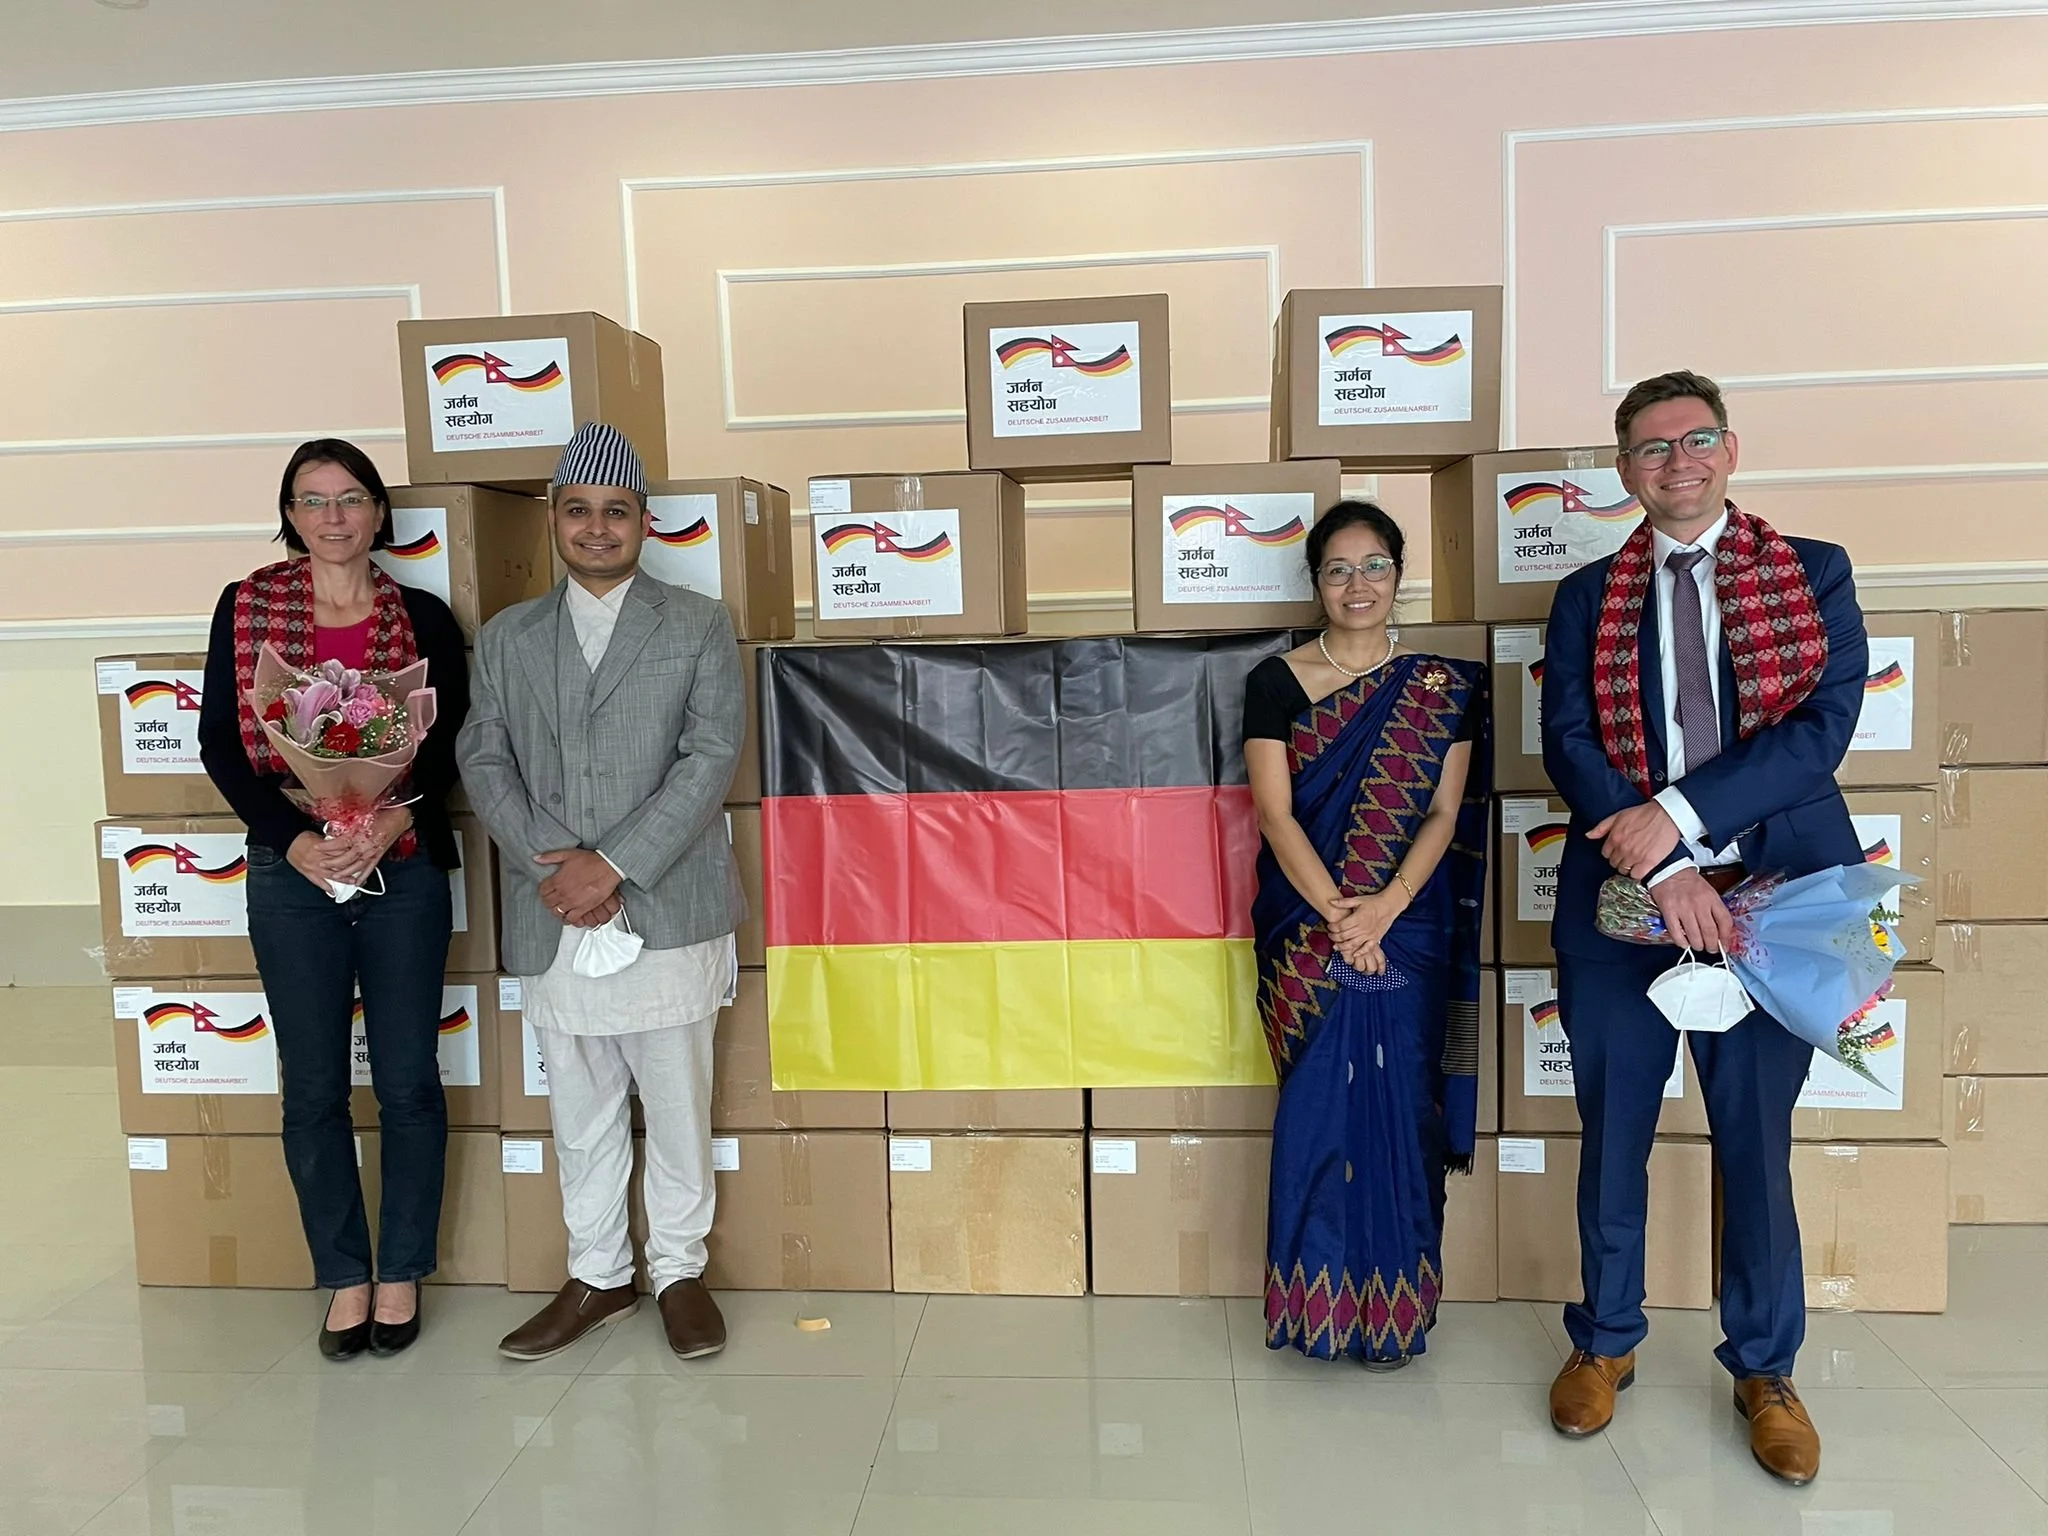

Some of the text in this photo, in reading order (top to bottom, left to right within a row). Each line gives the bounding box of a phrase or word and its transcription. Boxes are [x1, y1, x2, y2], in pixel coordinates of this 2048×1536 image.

[1334, 367, 1372, 382] जर्मन
[1006, 379, 1043, 393] जर्मन
[1334, 384, 1385, 400] सहयोग
[444, 394, 478, 410] जर्मन
[1007, 396, 1057, 412] सहयोग
[445, 411, 493, 427] सहयोग
[446, 433, 480, 441] DEUTSCHE
[1514, 524, 1552, 539] जर्मन
[1178, 546, 1215, 560] जर्मन
[1514, 541, 1567, 557] सहयोग
[832, 563, 867, 577] जर्मन
[1178, 564, 1229, 579] सहयोग
[832, 580, 880, 595] सहयोग
[833, 601, 869, 609] DEUTSCHE
[134, 720, 168, 732] जर्मन
[135, 736, 181, 750] सहयोग
[134, 883, 168, 896] जर्मन
[135, 899, 181, 913] सहयोग
[153, 1041, 186, 1053] जर्मन
[154, 1057, 199, 1071] सहयोग
